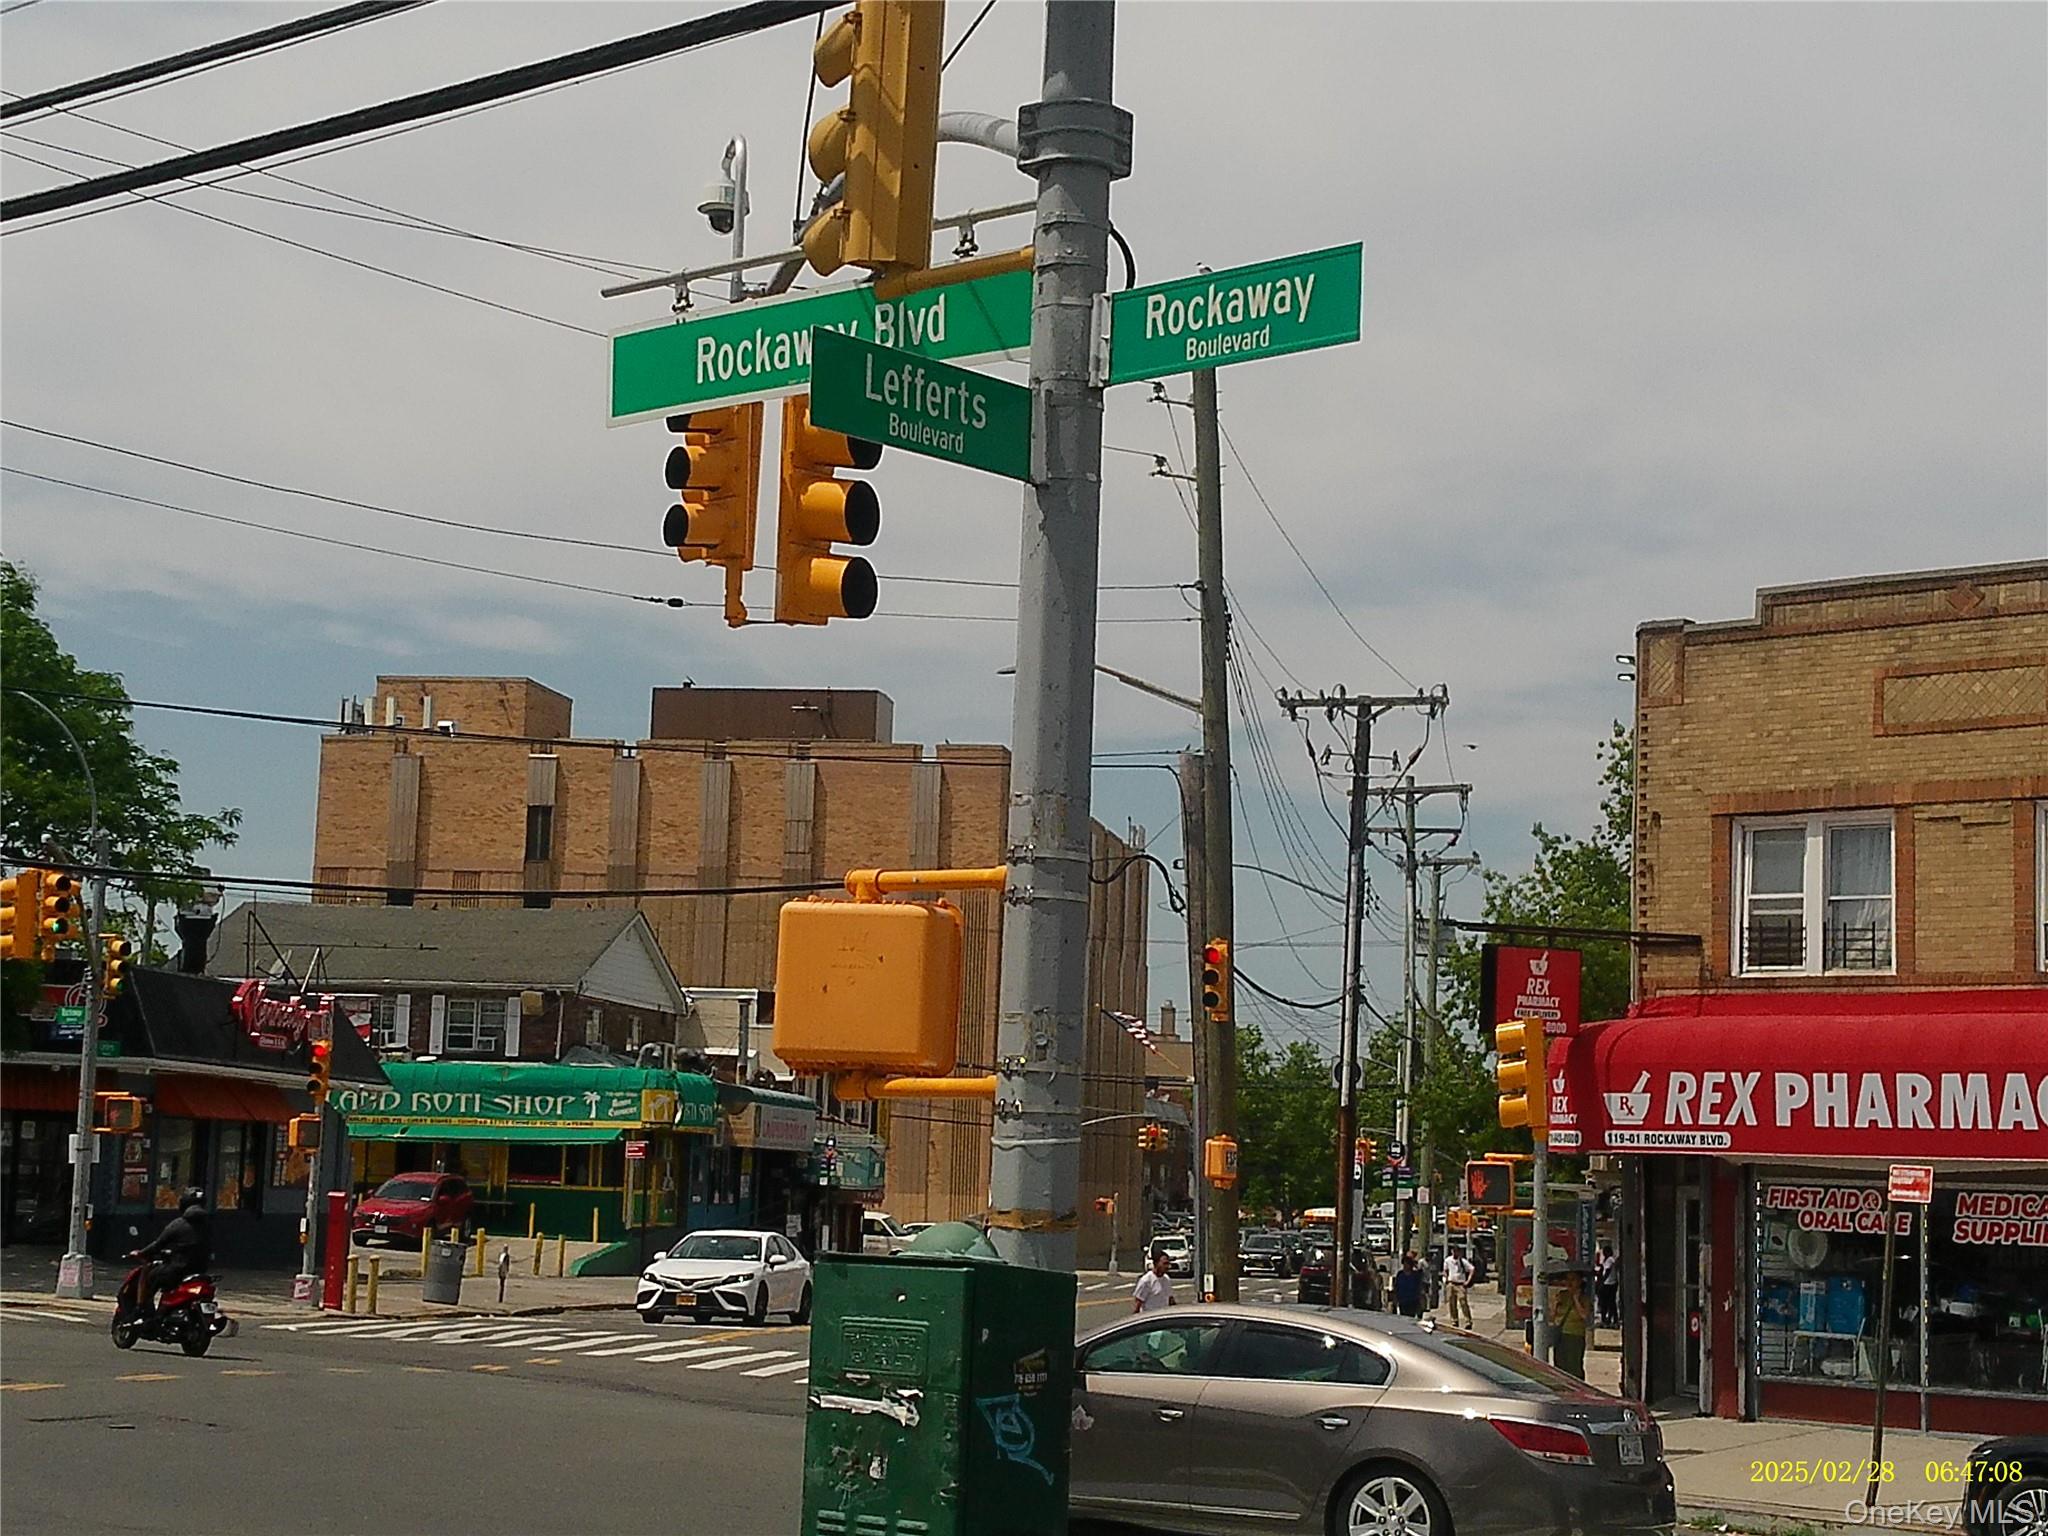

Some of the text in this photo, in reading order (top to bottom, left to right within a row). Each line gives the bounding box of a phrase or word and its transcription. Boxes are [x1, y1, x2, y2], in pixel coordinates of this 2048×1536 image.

[1146, 272, 1315, 340] Rockaway
[874, 292, 945, 348] Blvd
[1186, 323, 1270, 361] Boulevard
[865, 352, 986, 429] Lefferts
[889, 412, 964, 454] Boulevard
[1526, 977, 1550, 995] REX
[1516, 995, 1560, 1007] PHARMACY
[411, 1091, 481, 1113] ROTI
[491, 1093, 576, 1115] SHOP
[1552, 1096, 1568, 1113] REX
[1664, 1072, 1761, 1126] REX
[1607, 1132, 1727, 1146] 119-01 ROCKAWAY BLVD.
[1767, 1187, 1882, 1212] FIRST AID &
[1798, 1209, 1912, 1236] ORAL CAE
